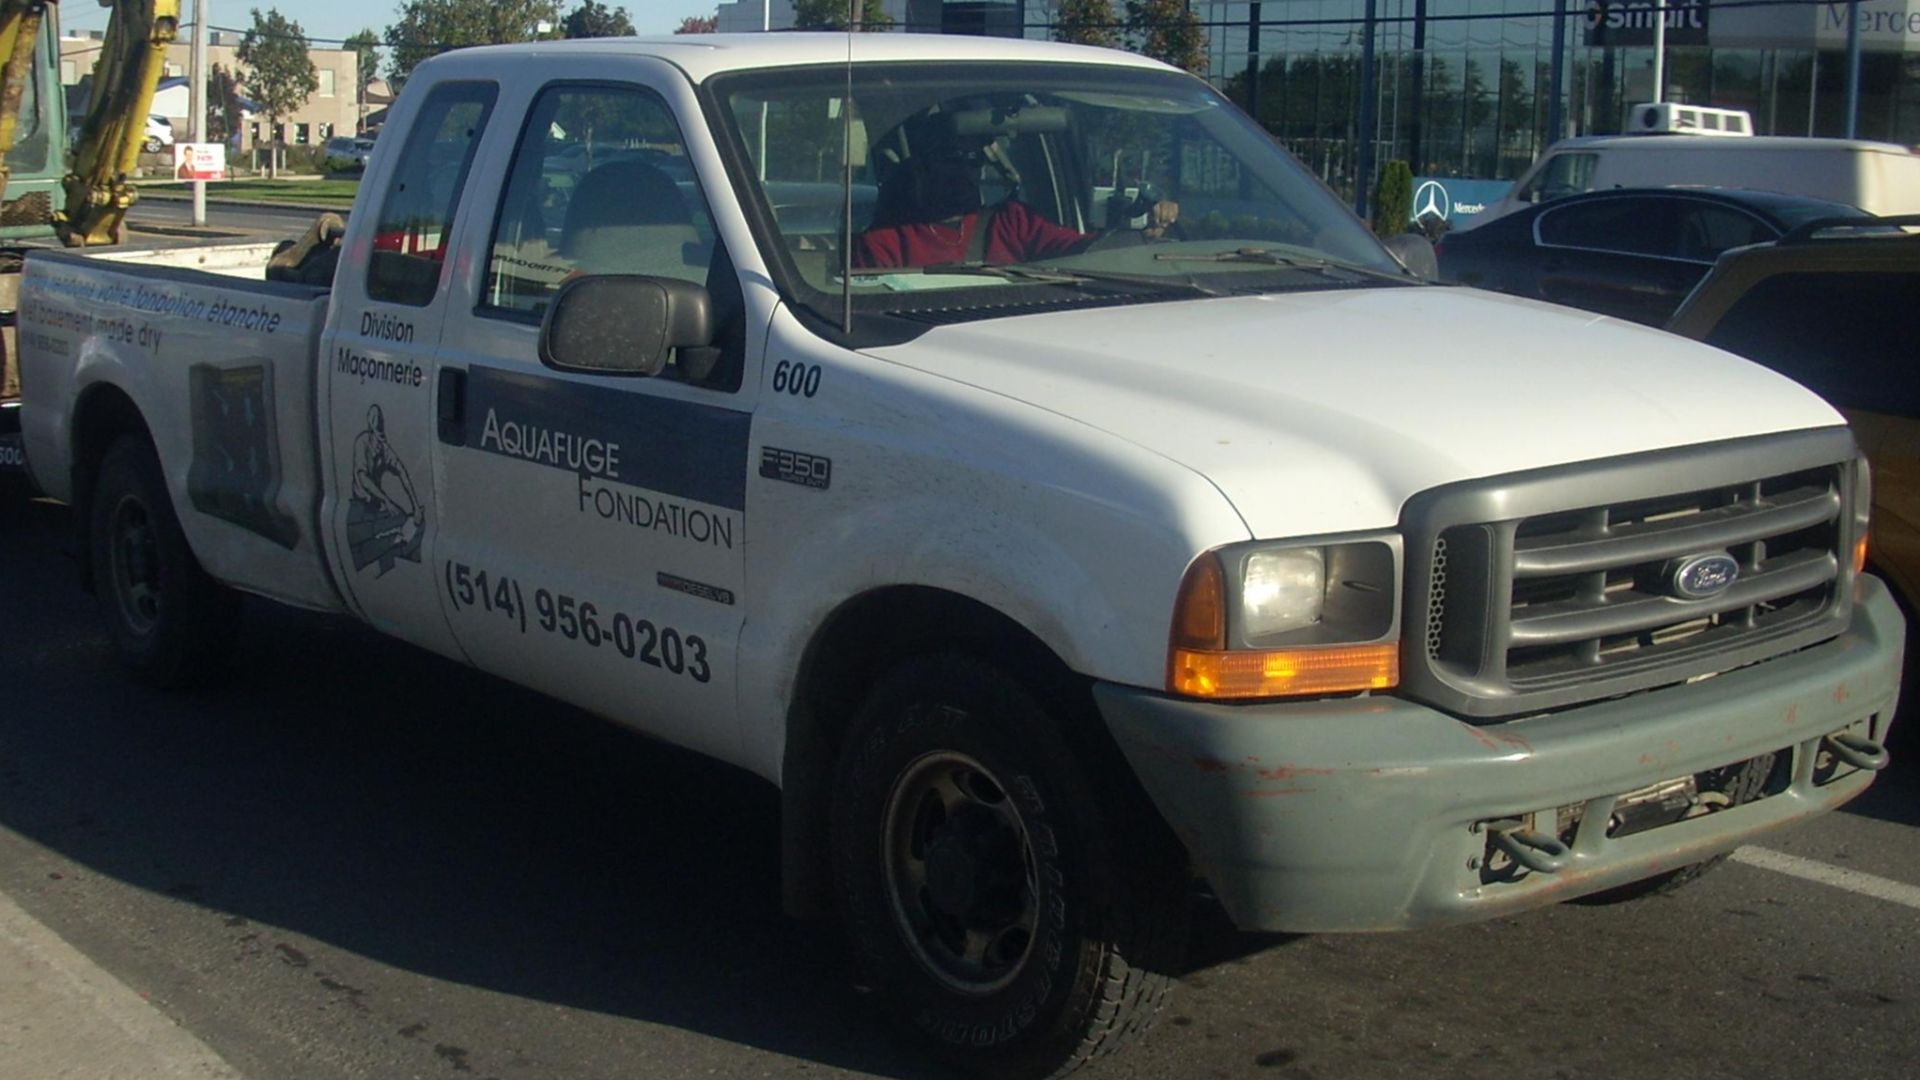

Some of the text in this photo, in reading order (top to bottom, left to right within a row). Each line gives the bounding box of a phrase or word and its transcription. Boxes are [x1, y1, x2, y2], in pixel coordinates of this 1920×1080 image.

[206, 294, 281, 333] étanche
[360, 311, 414, 344] Division
[138, 320, 163, 354] dry
[337, 347, 423, 388] Maçonnerie
[772, 359, 822, 398] 600
[481, 406, 620, 478] AQUAFUGE
[578, 472, 733, 549] FONDATION
[1693, 562, 1728, 589] Ford
[446, 559, 711, 683] (514) 956-0203
